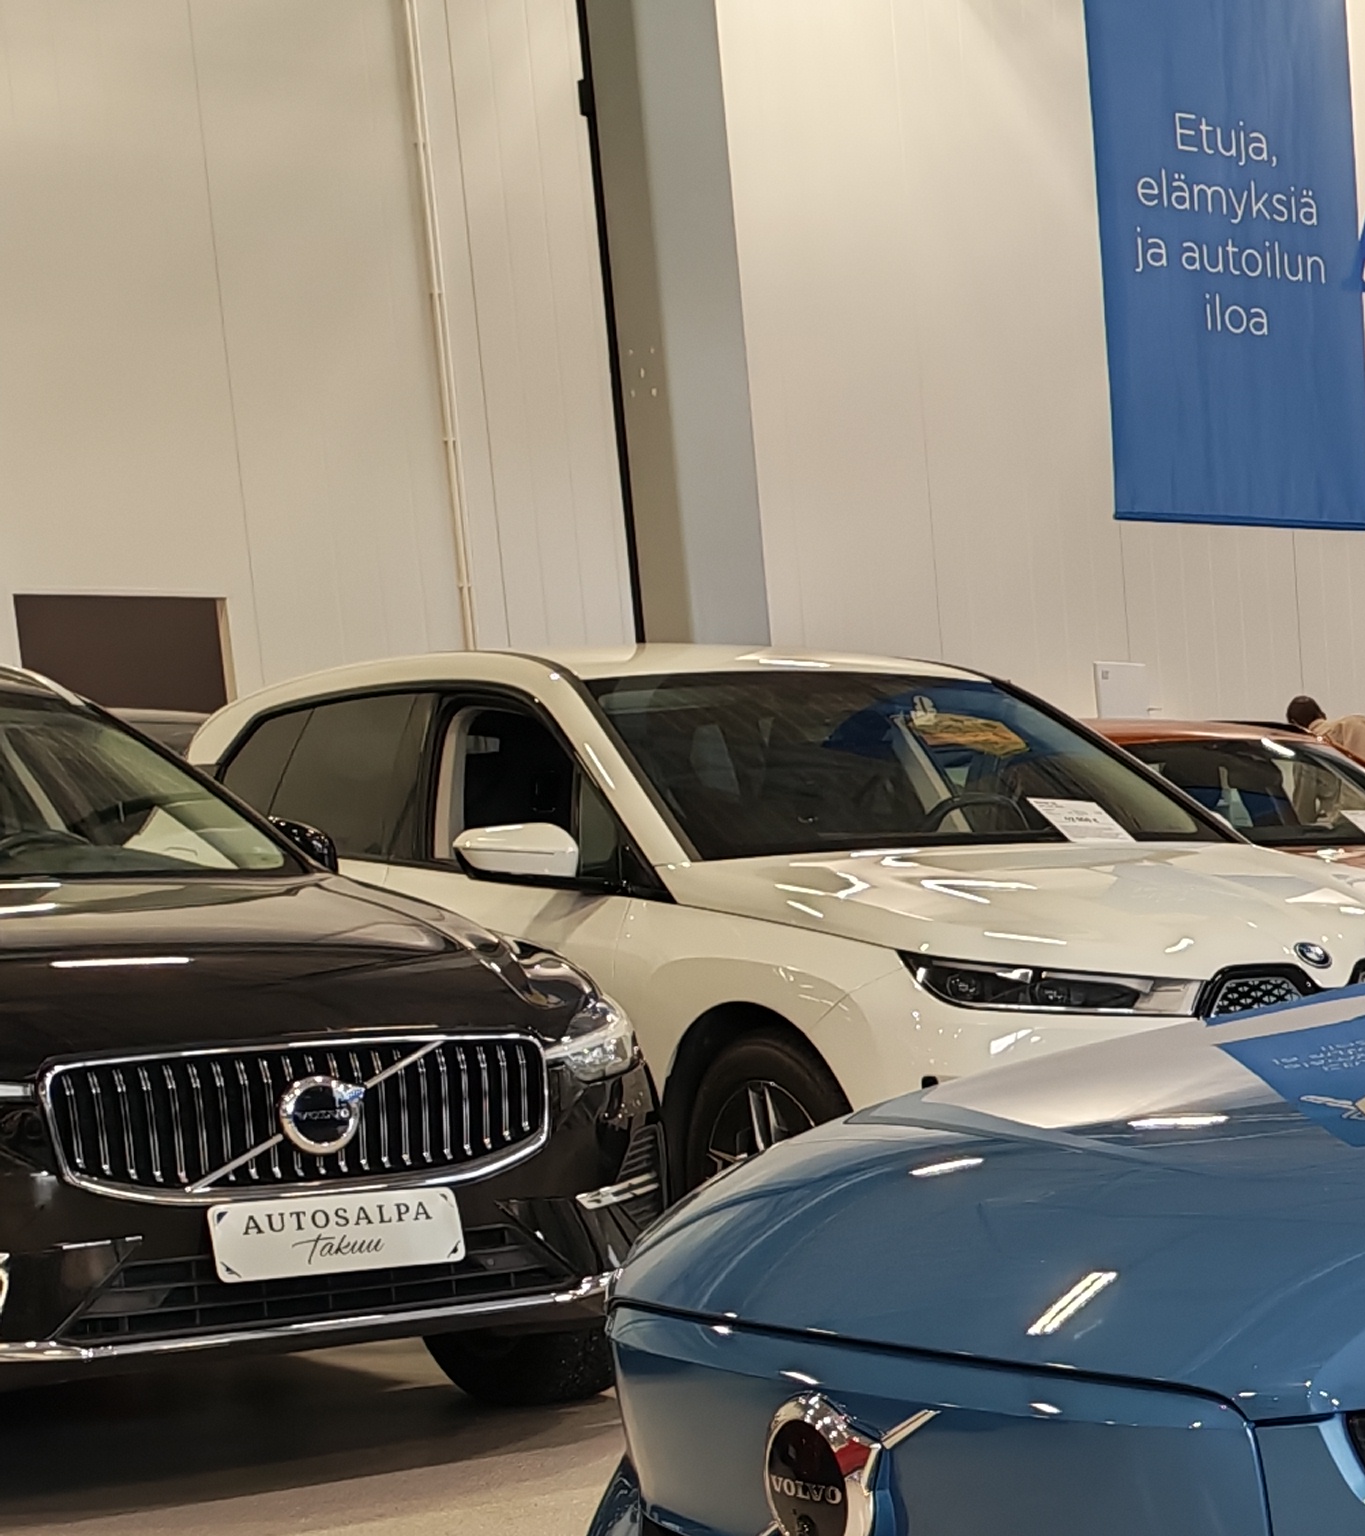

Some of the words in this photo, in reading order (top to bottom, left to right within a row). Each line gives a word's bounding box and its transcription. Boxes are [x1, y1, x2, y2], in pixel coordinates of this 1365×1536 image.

[1174, 112, 1278, 168] Etuja,
[1136, 168, 1319, 226] elämyksiä
[1134, 226, 1168, 273] ja
[1180, 238, 1327, 285] autoilun
[1204, 292, 1269, 337] iloa
[241, 1201, 435, 1237] AUTOSALPA
[291, 1231, 386, 1266] Takuu
[770, 1474, 844, 1507] VOLVO
